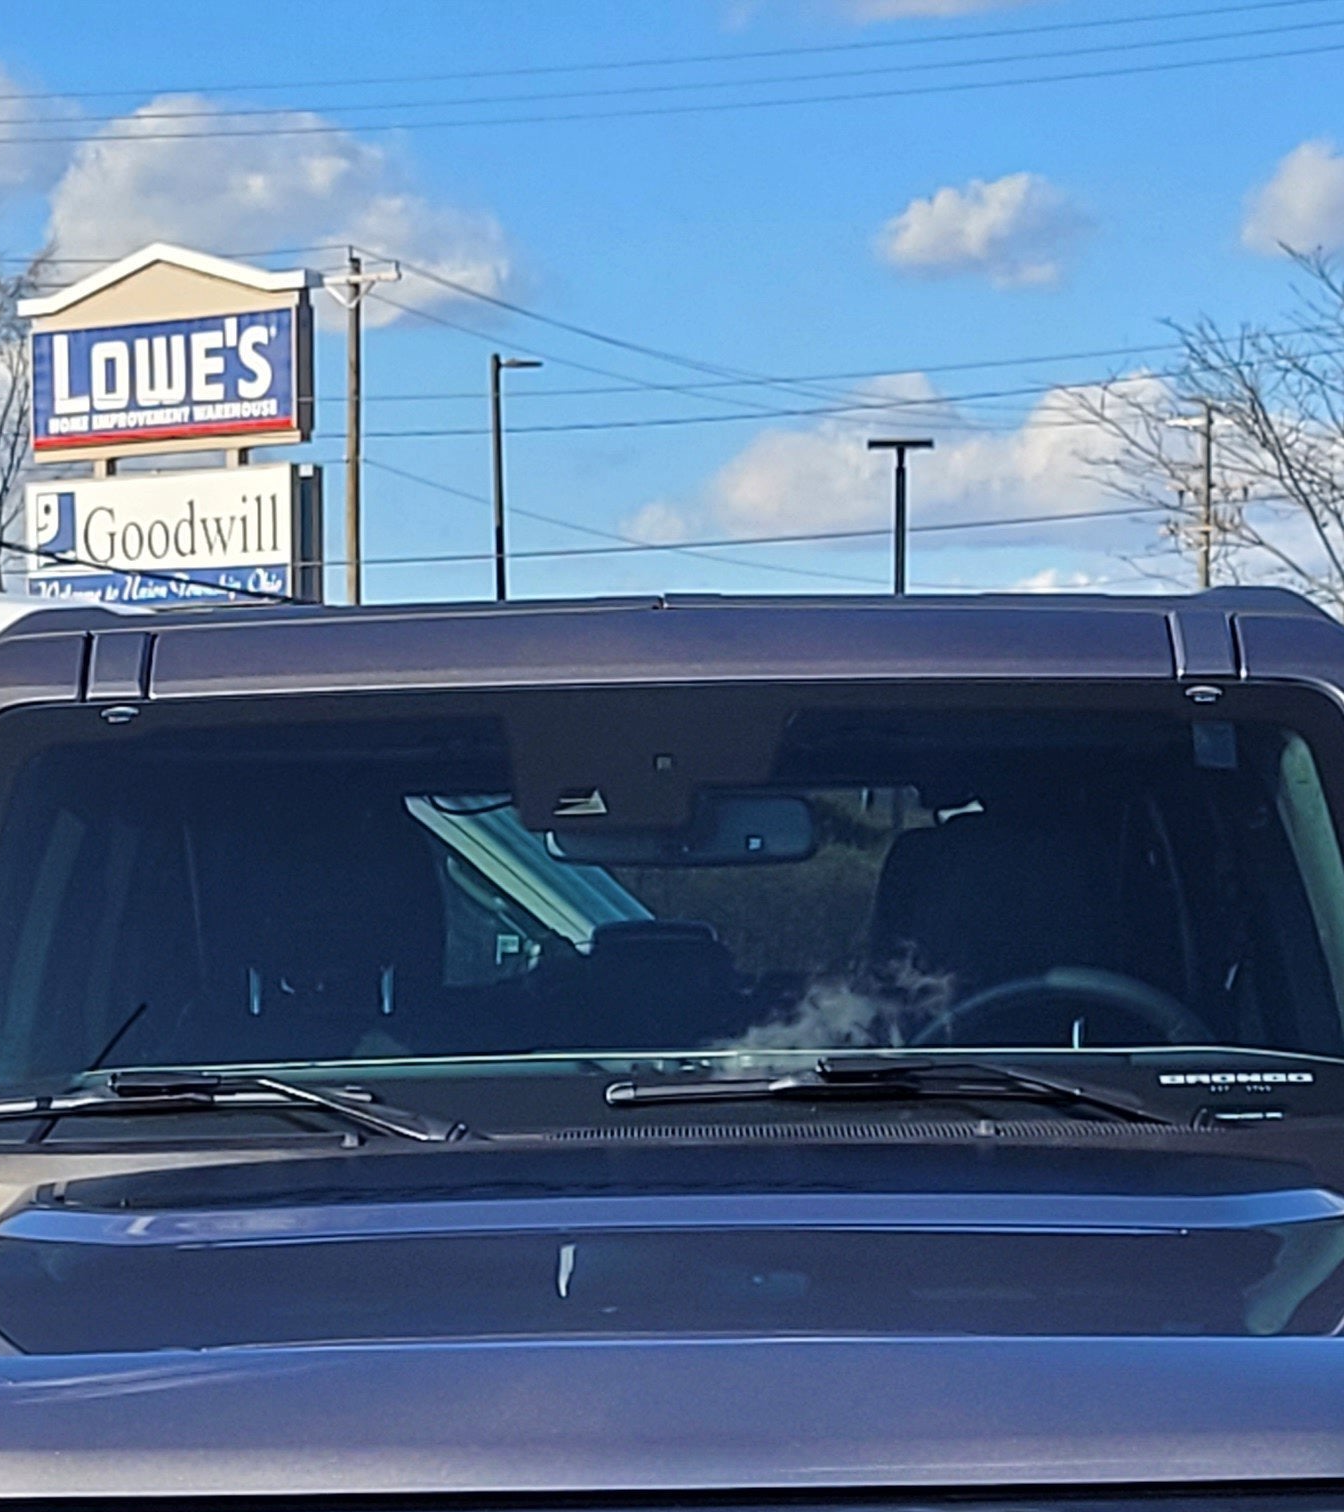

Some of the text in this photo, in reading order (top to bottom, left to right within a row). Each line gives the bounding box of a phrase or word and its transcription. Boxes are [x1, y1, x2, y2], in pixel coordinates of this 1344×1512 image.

[53, 317, 273, 414] LOWE'S
[48, 399, 278, 435] HOME IMPROVEMENT WAREHOUSE
[83, 493, 281, 564] Goodwill
